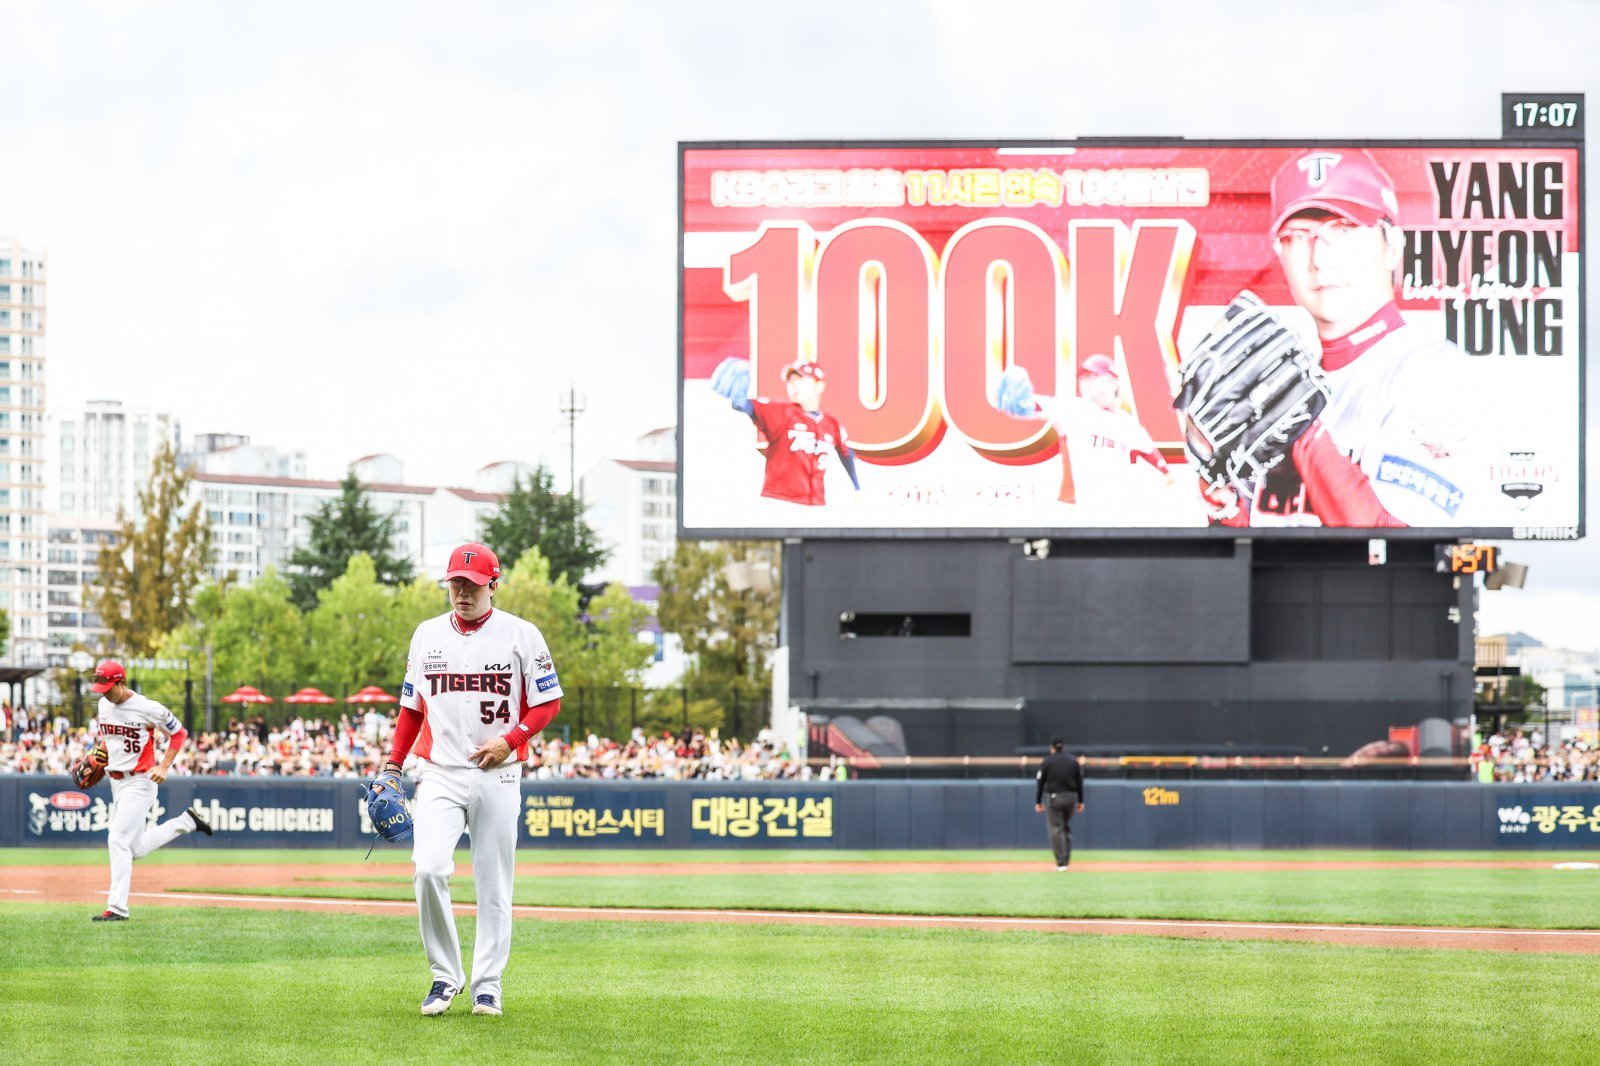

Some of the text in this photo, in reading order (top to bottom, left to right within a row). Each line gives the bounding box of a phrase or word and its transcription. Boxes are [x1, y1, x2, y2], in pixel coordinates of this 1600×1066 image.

[1513, 102, 1578, 127] 17:07
[1430, 161, 1564, 220] YANG
[1402, 229, 1563, 288] HYEON
[724, 217, 1194, 456] 100K
[462, 552, 477, 565] T
[484, 663, 511, 671] KIA
[424, 673, 513, 696] TIGERS
[480, 700, 511, 725] 54
[123, 739, 141, 753] 36
[1142, 786, 1180, 806] 121m
[249, 807, 334, 833] CHICKEN
[525, 808, 665, 837] 챔피언스시티
[691, 796, 834, 837] 대방건설
